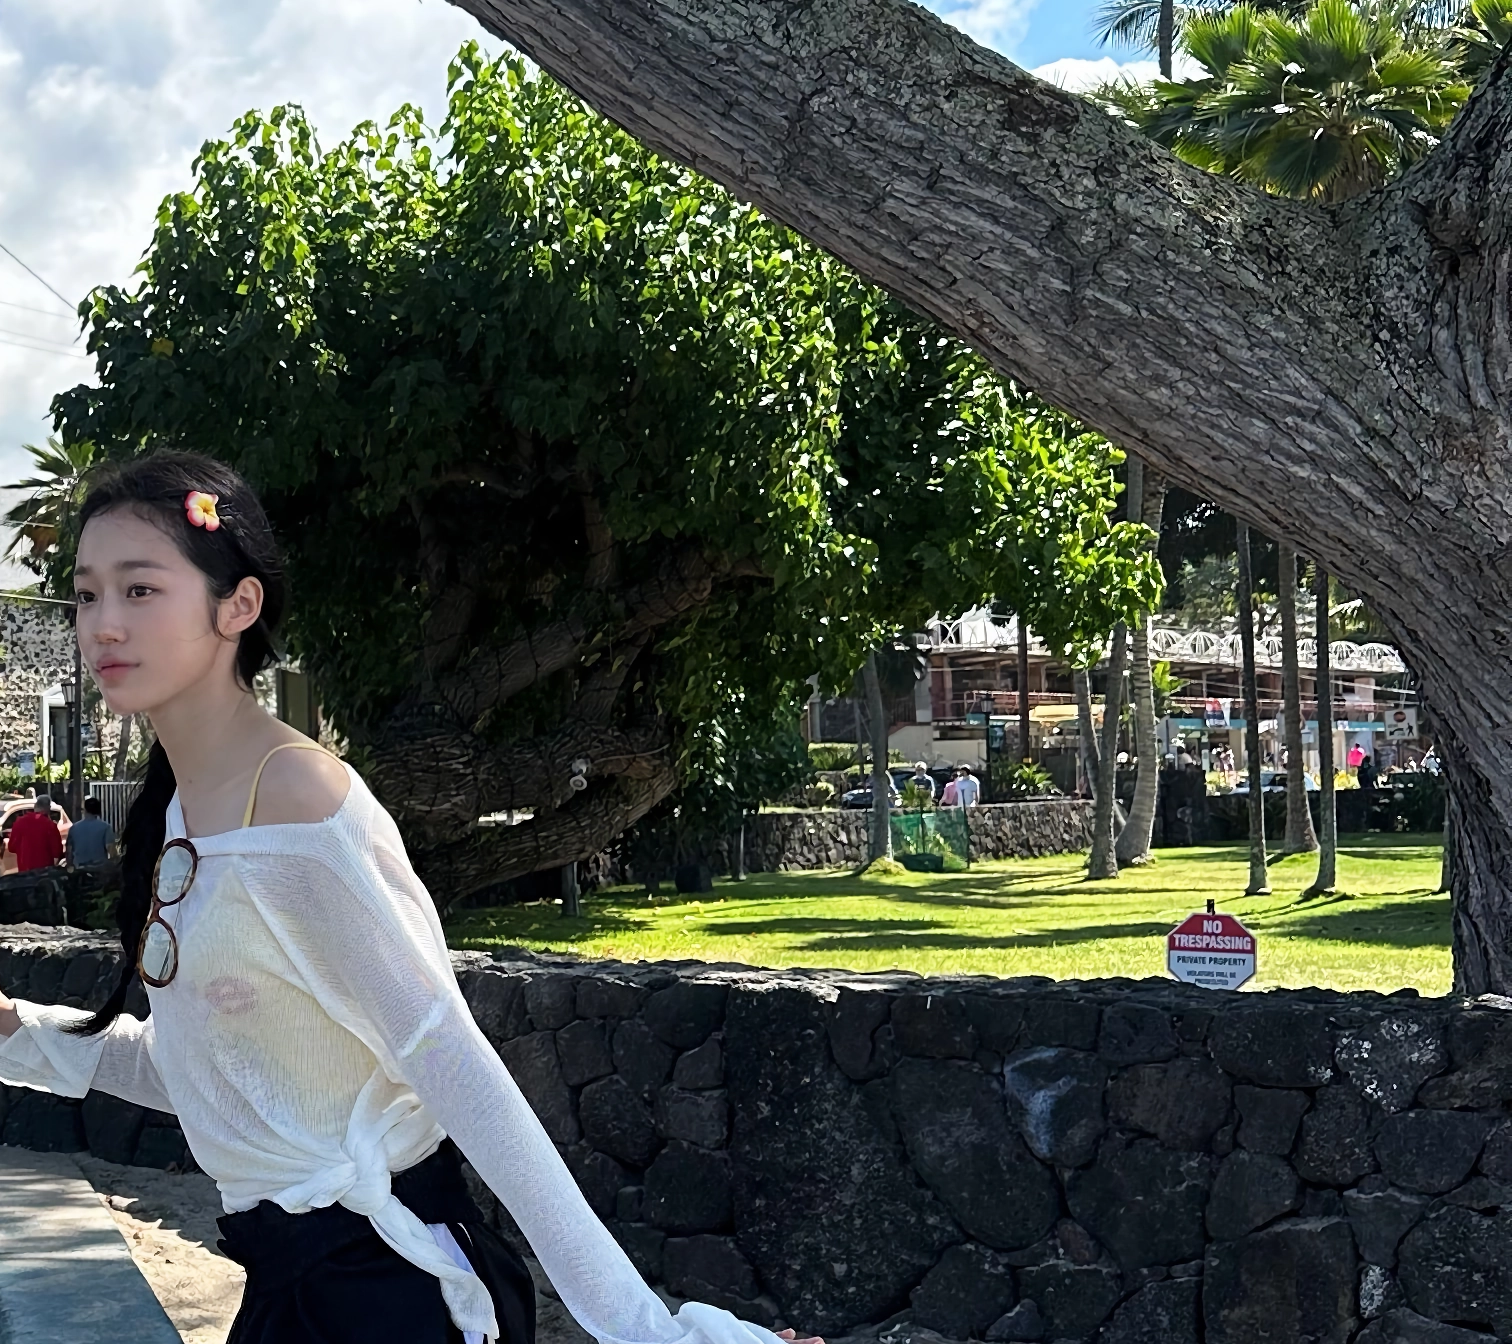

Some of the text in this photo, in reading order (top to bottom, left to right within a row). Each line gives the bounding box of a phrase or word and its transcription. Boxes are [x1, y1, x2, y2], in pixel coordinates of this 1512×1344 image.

[1203, 920, 1222, 933] NO
[1173, 934, 1252, 950] TRESPASSING
[1176, 956, 1246, 966] PRIVATE PROPERTY
